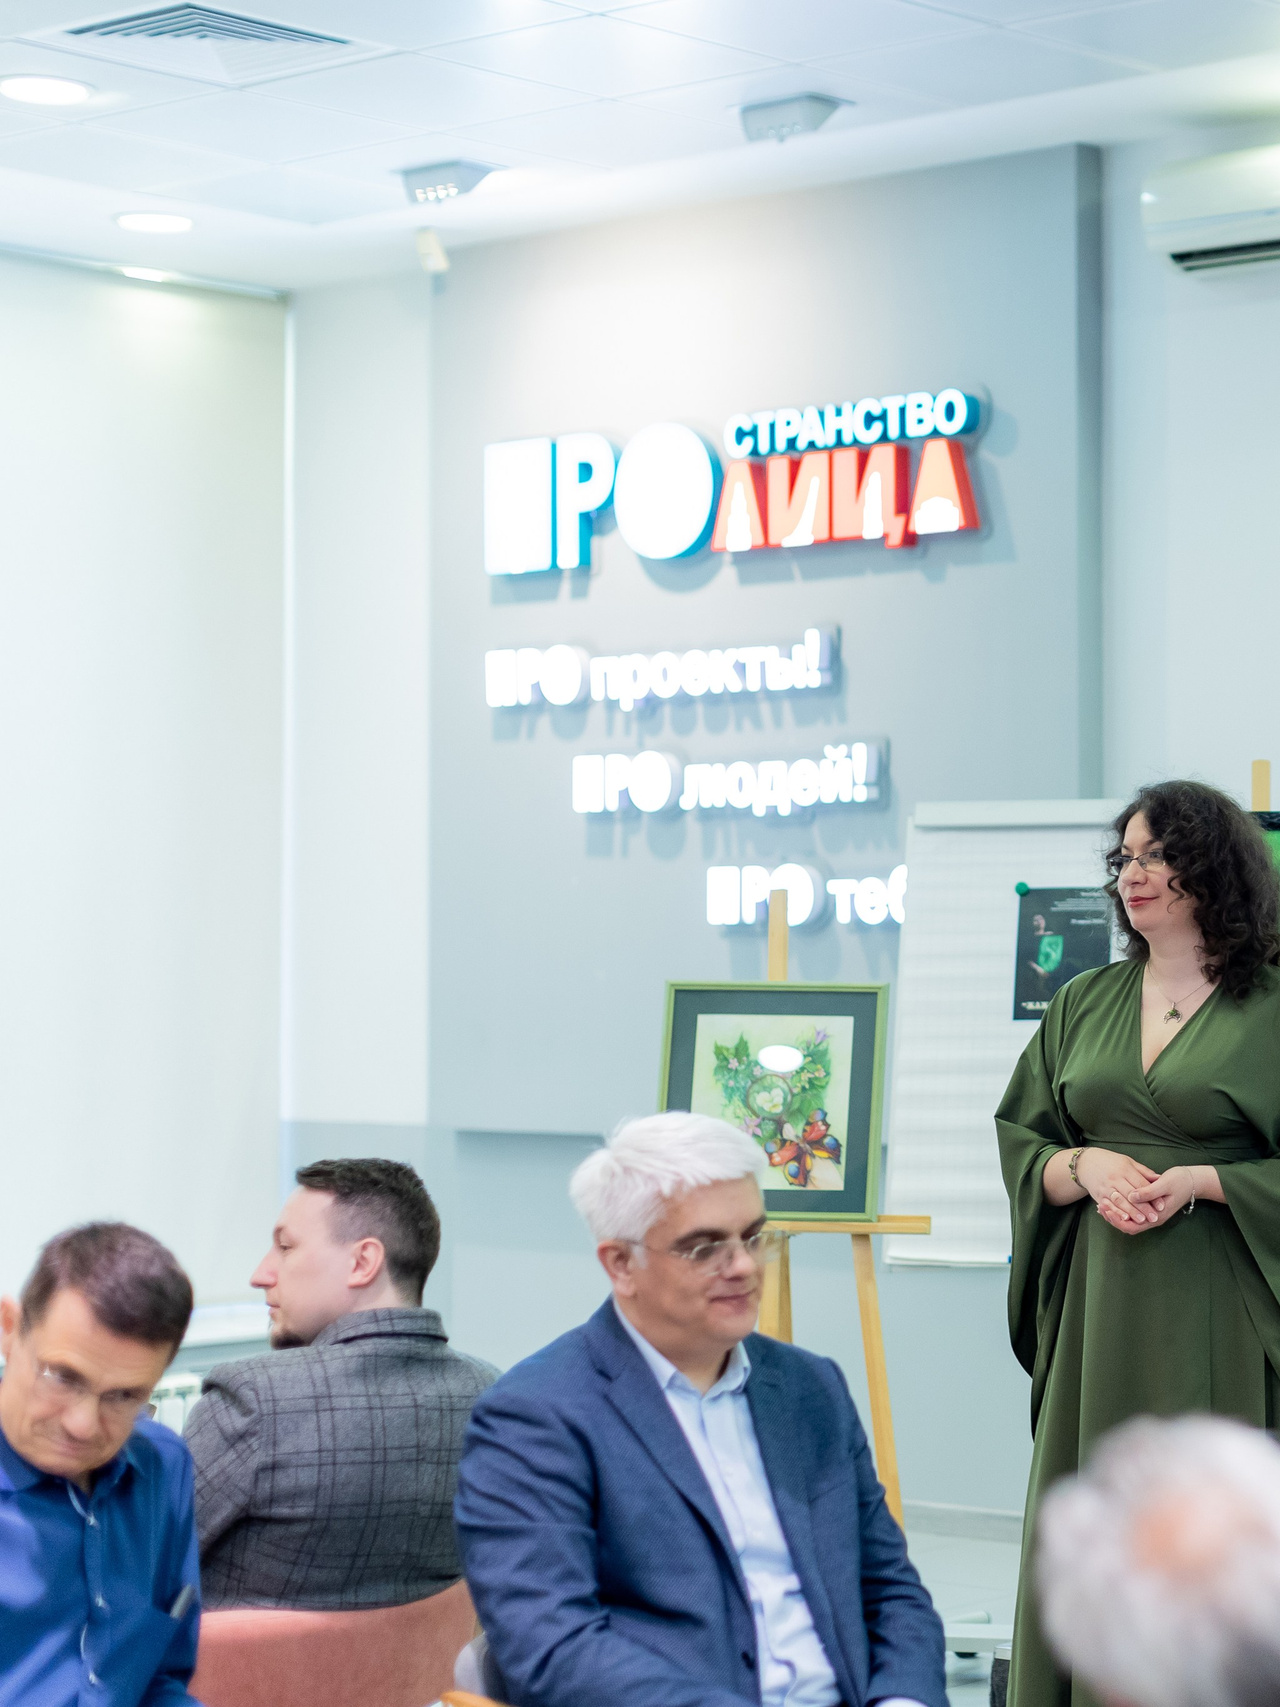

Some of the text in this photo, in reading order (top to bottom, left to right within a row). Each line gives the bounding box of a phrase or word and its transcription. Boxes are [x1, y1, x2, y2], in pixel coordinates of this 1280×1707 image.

[723, 388, 968, 459] СТРАНСТВО
[484, 422, 715, 576] ПРО
[711, 438, 972, 552] ЛИЦА
[485, 628, 822, 712] ПРО проекты!
[572, 742, 868, 817] ПРО людей!
[706, 863, 815, 926] ПРО
